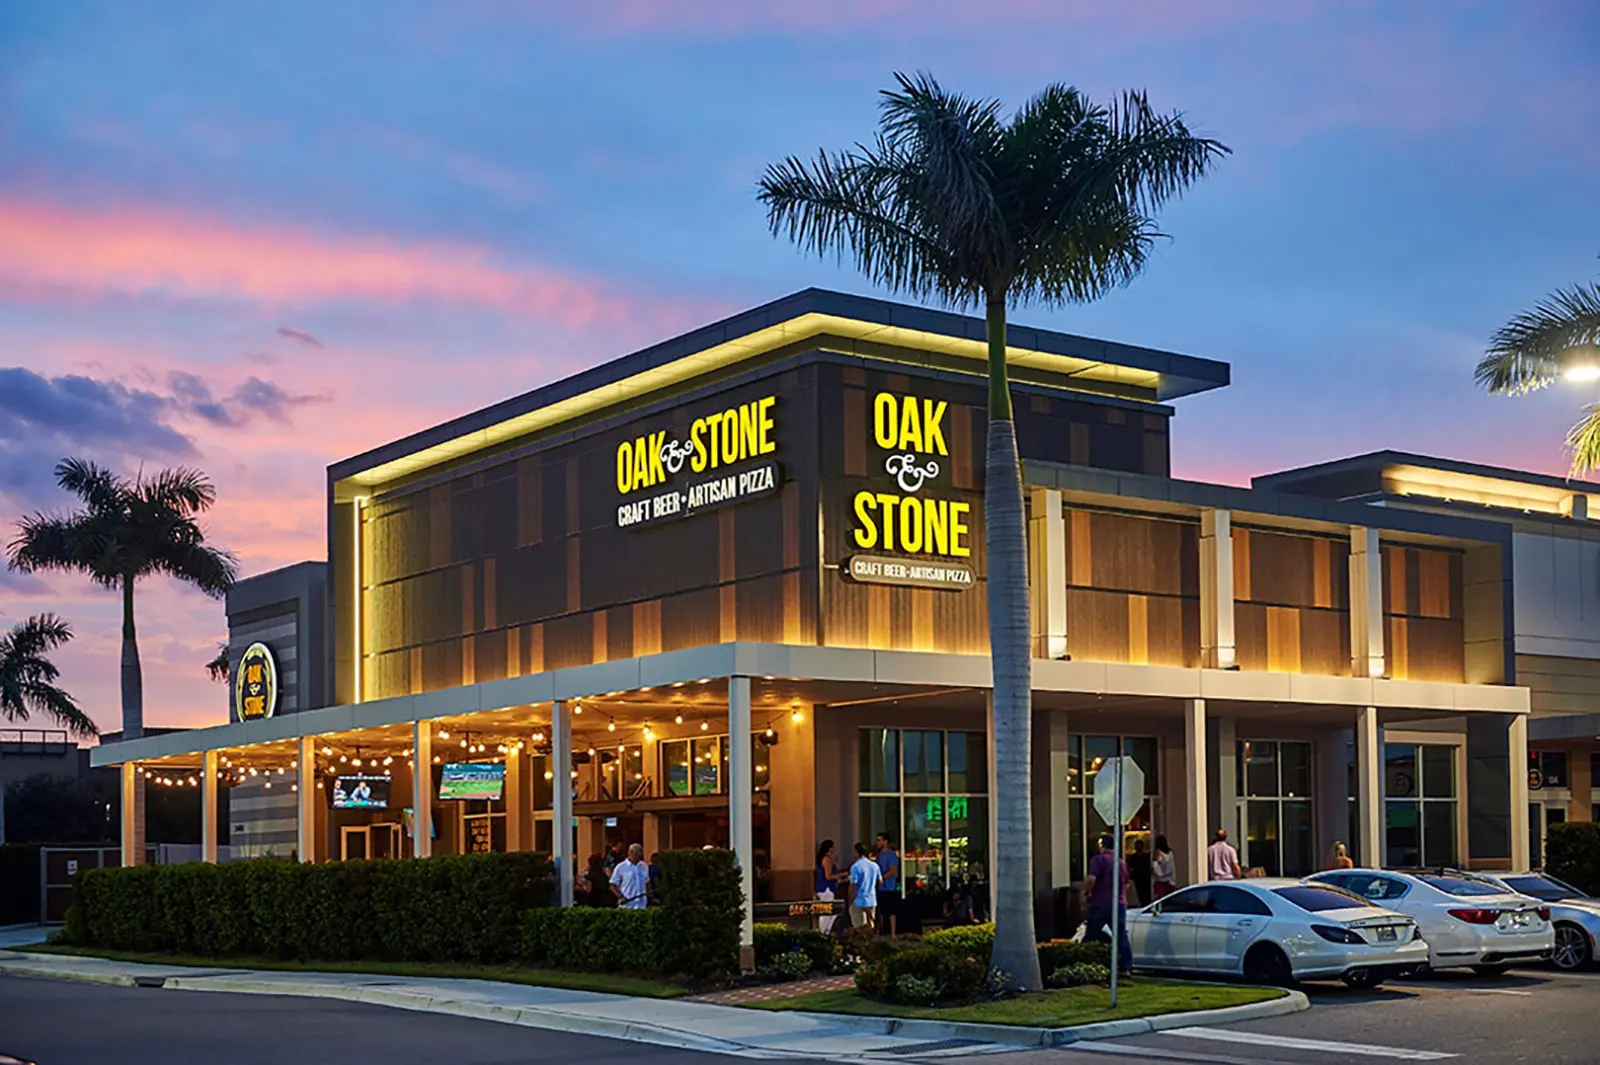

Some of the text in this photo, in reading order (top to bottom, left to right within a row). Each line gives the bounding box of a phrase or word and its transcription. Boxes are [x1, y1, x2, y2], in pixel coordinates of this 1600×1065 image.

[617, 430, 666, 494] OAK
[691, 396, 775, 473] STONE
[874, 392, 949, 456] OAK
[617, 499, 650, 527] CRAFT
[739, 466, 774, 495] PIZZA
[885, 454, 939, 492] &
[854, 491, 970, 557] STONE
[855, 561, 882, 575] CRAFT
[946, 569, 971, 583] PIZZA
